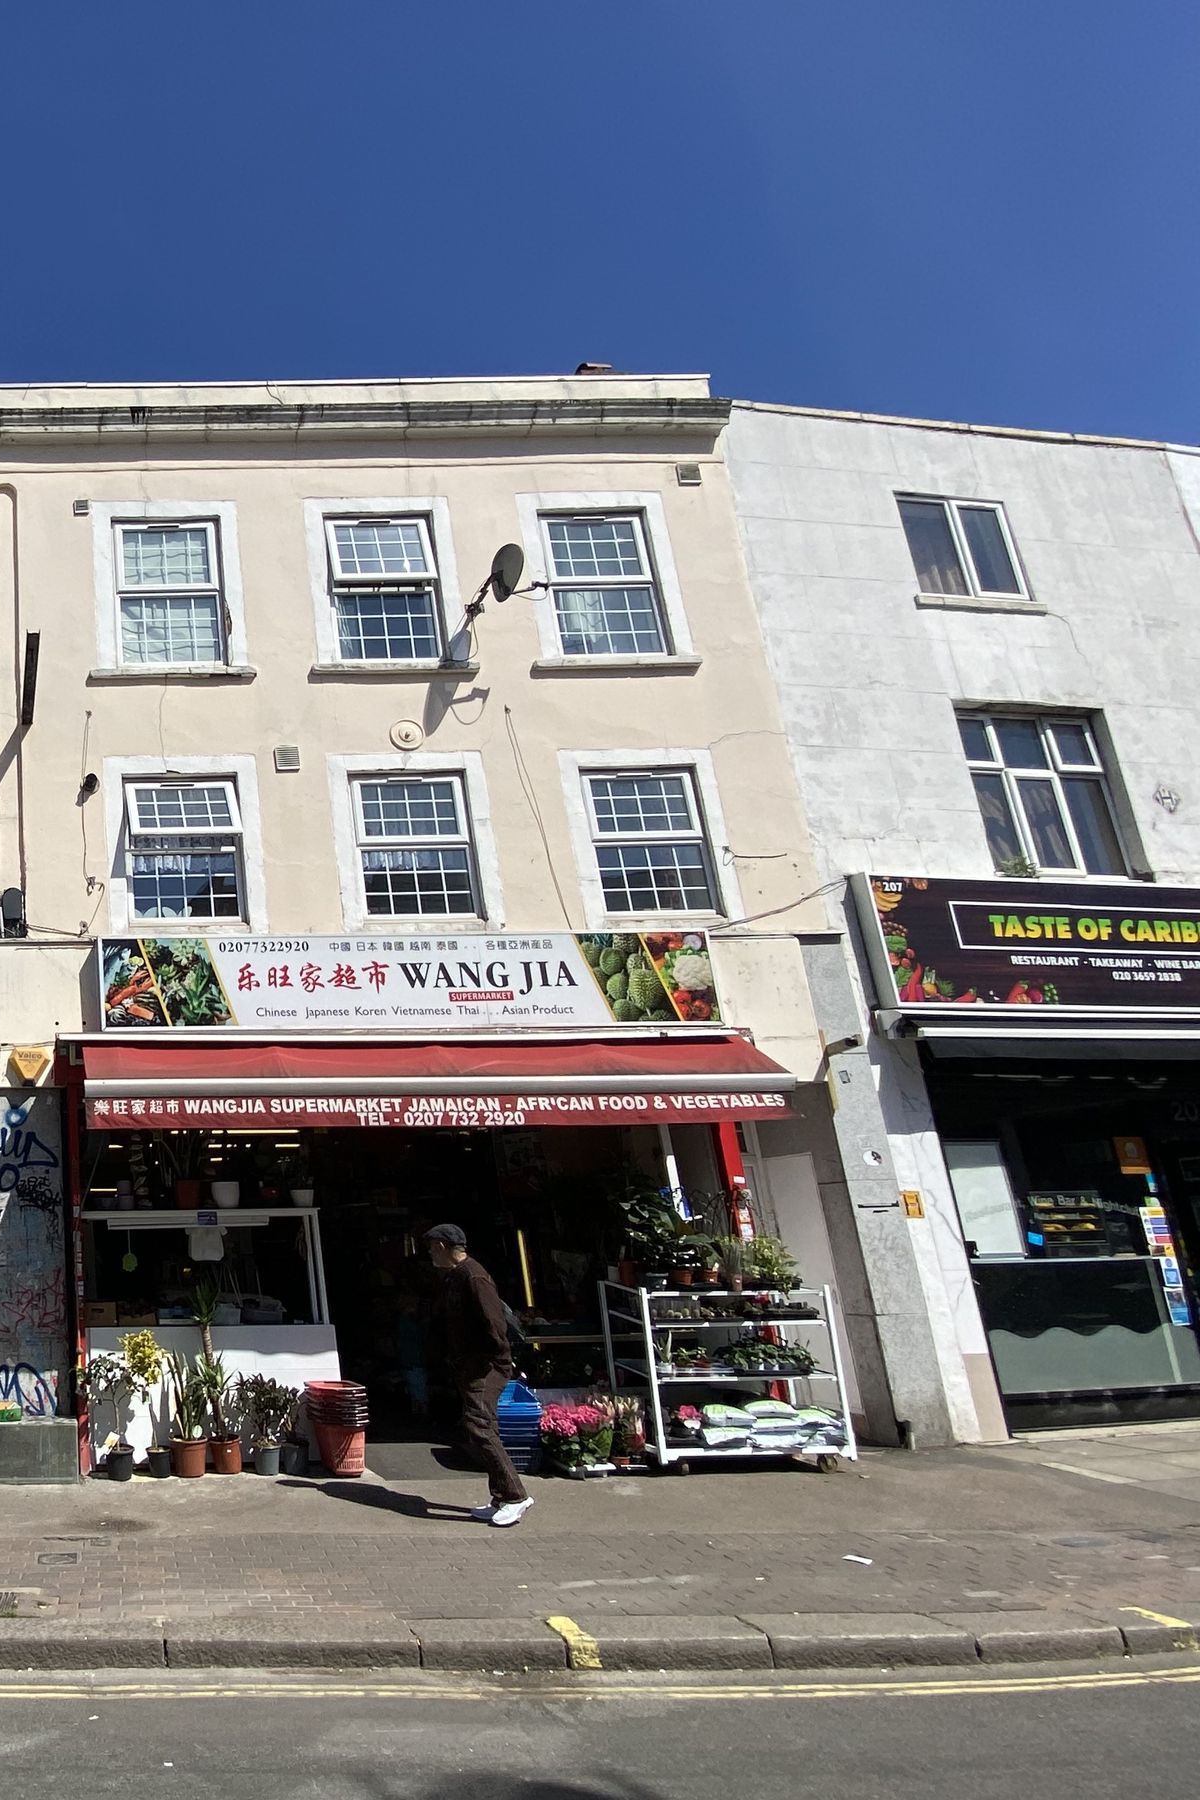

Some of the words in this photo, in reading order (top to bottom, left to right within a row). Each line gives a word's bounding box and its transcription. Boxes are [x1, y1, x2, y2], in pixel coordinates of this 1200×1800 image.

[882, 882, 903, 892] 207
[988, 914, 1073, 939] TASTE
[1077, 918, 1113, 941] OF
[1120, 919, 1200, 943] CARIB
[218, 941, 310, 953] 02077322920
[356, 941, 378, 952] 日本
[382, 941, 405, 952] 韓國
[409, 941, 431, 951] 越南
[1010, 955, 1079, 967] RESTAURANT
[1088, 957, 1143, 968] TAKEAWAY
[1153, 959, 1182, 969] WINE
[396, 961, 511, 989] WANG
[518, 960, 579, 996] JIA
[1112, 971, 1132, 981] 020
[1132, 971, 1156, 981] 3659
[451, 991, 513, 1001] SUPERMARKET
[255, 1006, 298, 1018] Chinese
[305, 1006, 350, 1019] Japanese
[354, 1006, 387, 1016] Koren
[391, 1006, 452, 1016] Vietnamese
[456, 1005, 480, 1015] Thai
[501, 1005, 530, 1015] Asian
[532, 1004, 575, 1015] Product
[94, 1099, 180, 1116] 樂旺家超市
[184, 1098, 266, 1114] WANGJIA
[270, 1098, 402, 1114] SUPERMARKET
[407, 1097, 500, 1114] JAMAICAN
[599, 1095, 648, 1111] FOOD
[653, 1095, 667, 1109] &
[669, 1093, 786, 1110] VEGETABLES
[357, 1112, 391, 1127] TEL
[404, 1112, 444, 1127] 0207
[449, 1111, 479, 1126] 732
[483, 1111, 525, 1126] 2920
